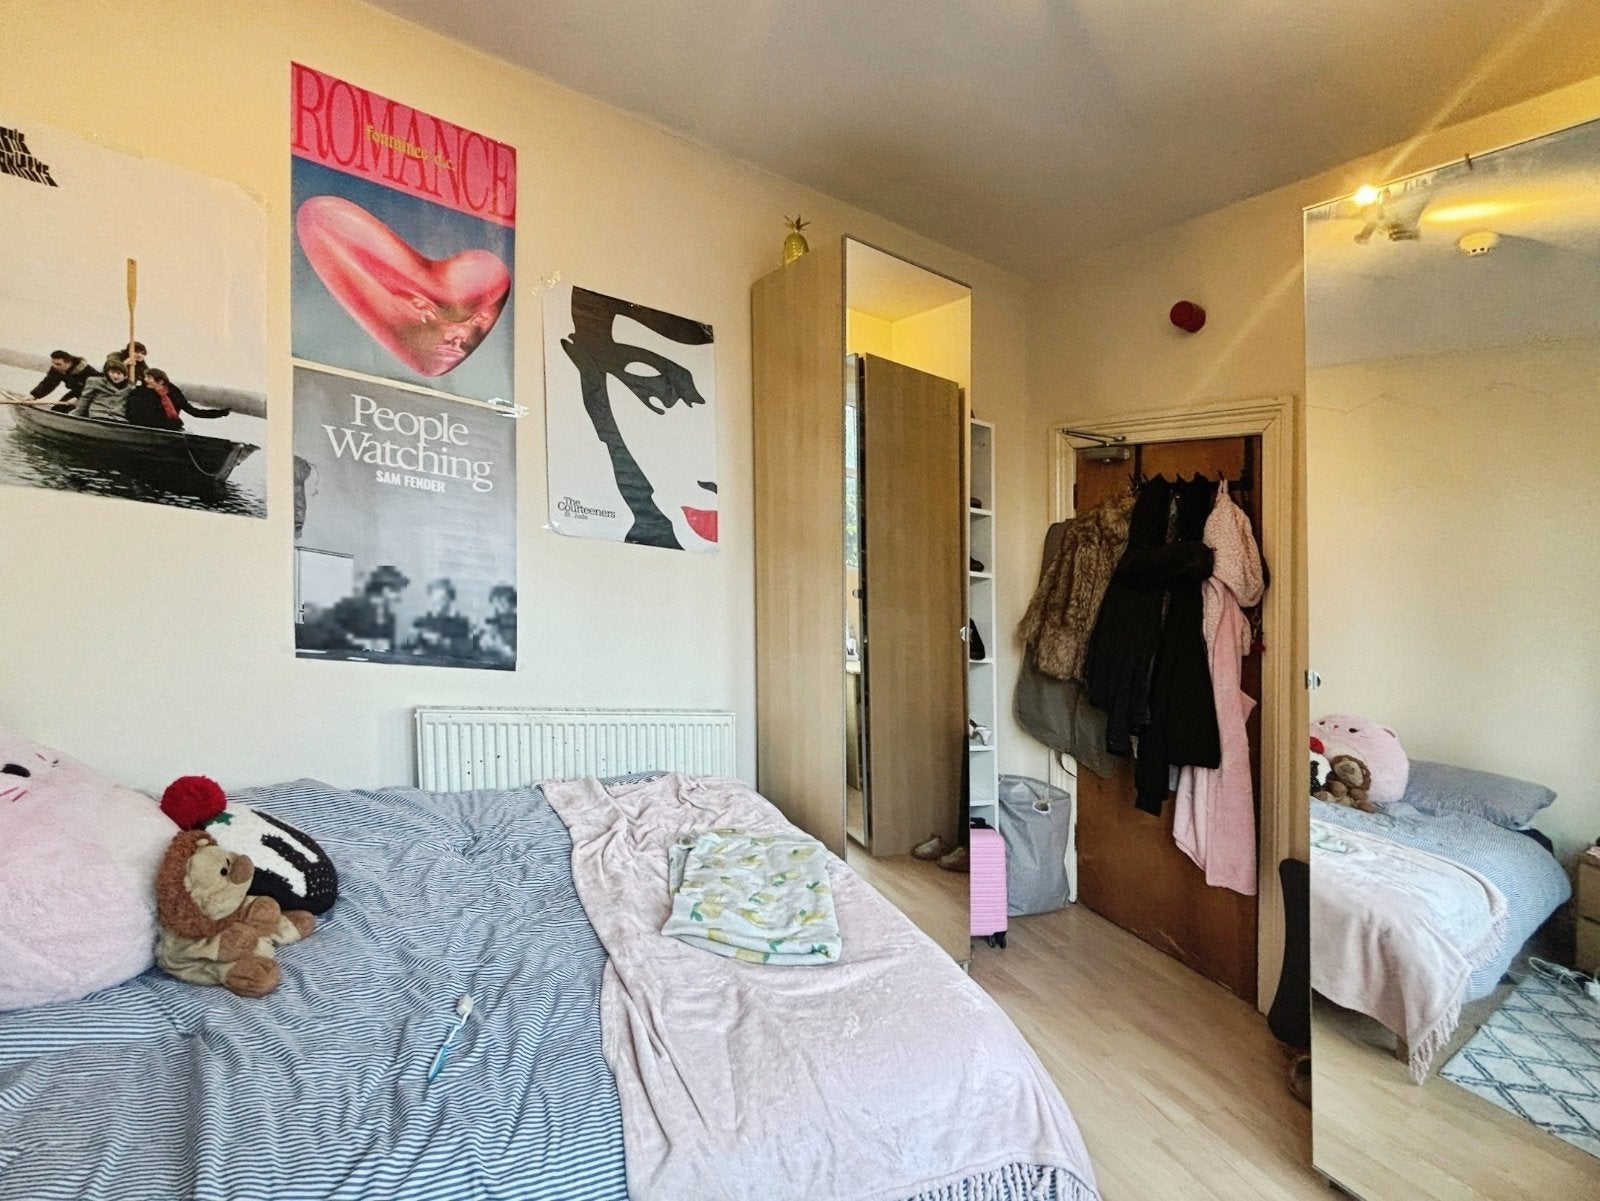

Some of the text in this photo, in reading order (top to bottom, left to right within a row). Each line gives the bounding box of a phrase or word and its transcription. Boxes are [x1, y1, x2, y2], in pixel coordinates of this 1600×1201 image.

[292, 62, 516, 220] ROMANCE
[0, 151, 59, 188] ONKEYS
[351, 394, 469, 446] People
[322, 424, 493, 492] Watching
[376, 470, 446, 493] SAM FENDER
[557, 501, 616, 518] Courteeners
[563, 496, 581, 507] The
